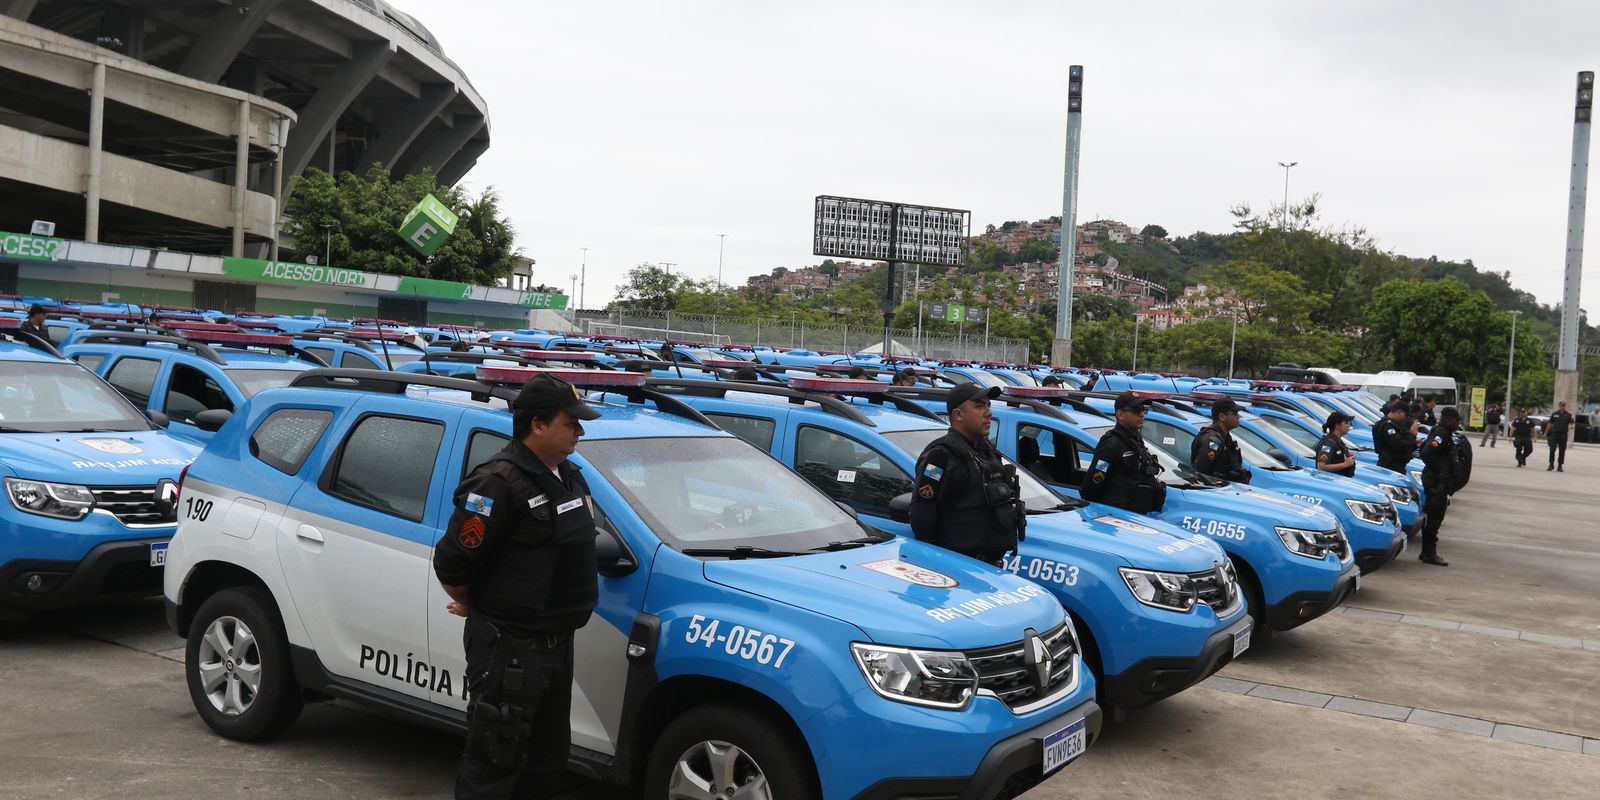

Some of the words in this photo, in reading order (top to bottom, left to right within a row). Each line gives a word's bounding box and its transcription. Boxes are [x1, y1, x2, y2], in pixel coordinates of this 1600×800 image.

[410, 222, 438, 248] E
[262, 261, 323, 283] ACESSO
[952, 308, 960, 320] 3
[186, 496, 213, 522] 190
[1181, 515, 1246, 541] 54-0555
[1002, 549, 1080, 587] 54-0553
[685, 614, 796, 669] 54-0567
[360, 643, 452, 697] POLÍCIA
[1047, 732, 1082, 769] FVN9E36
